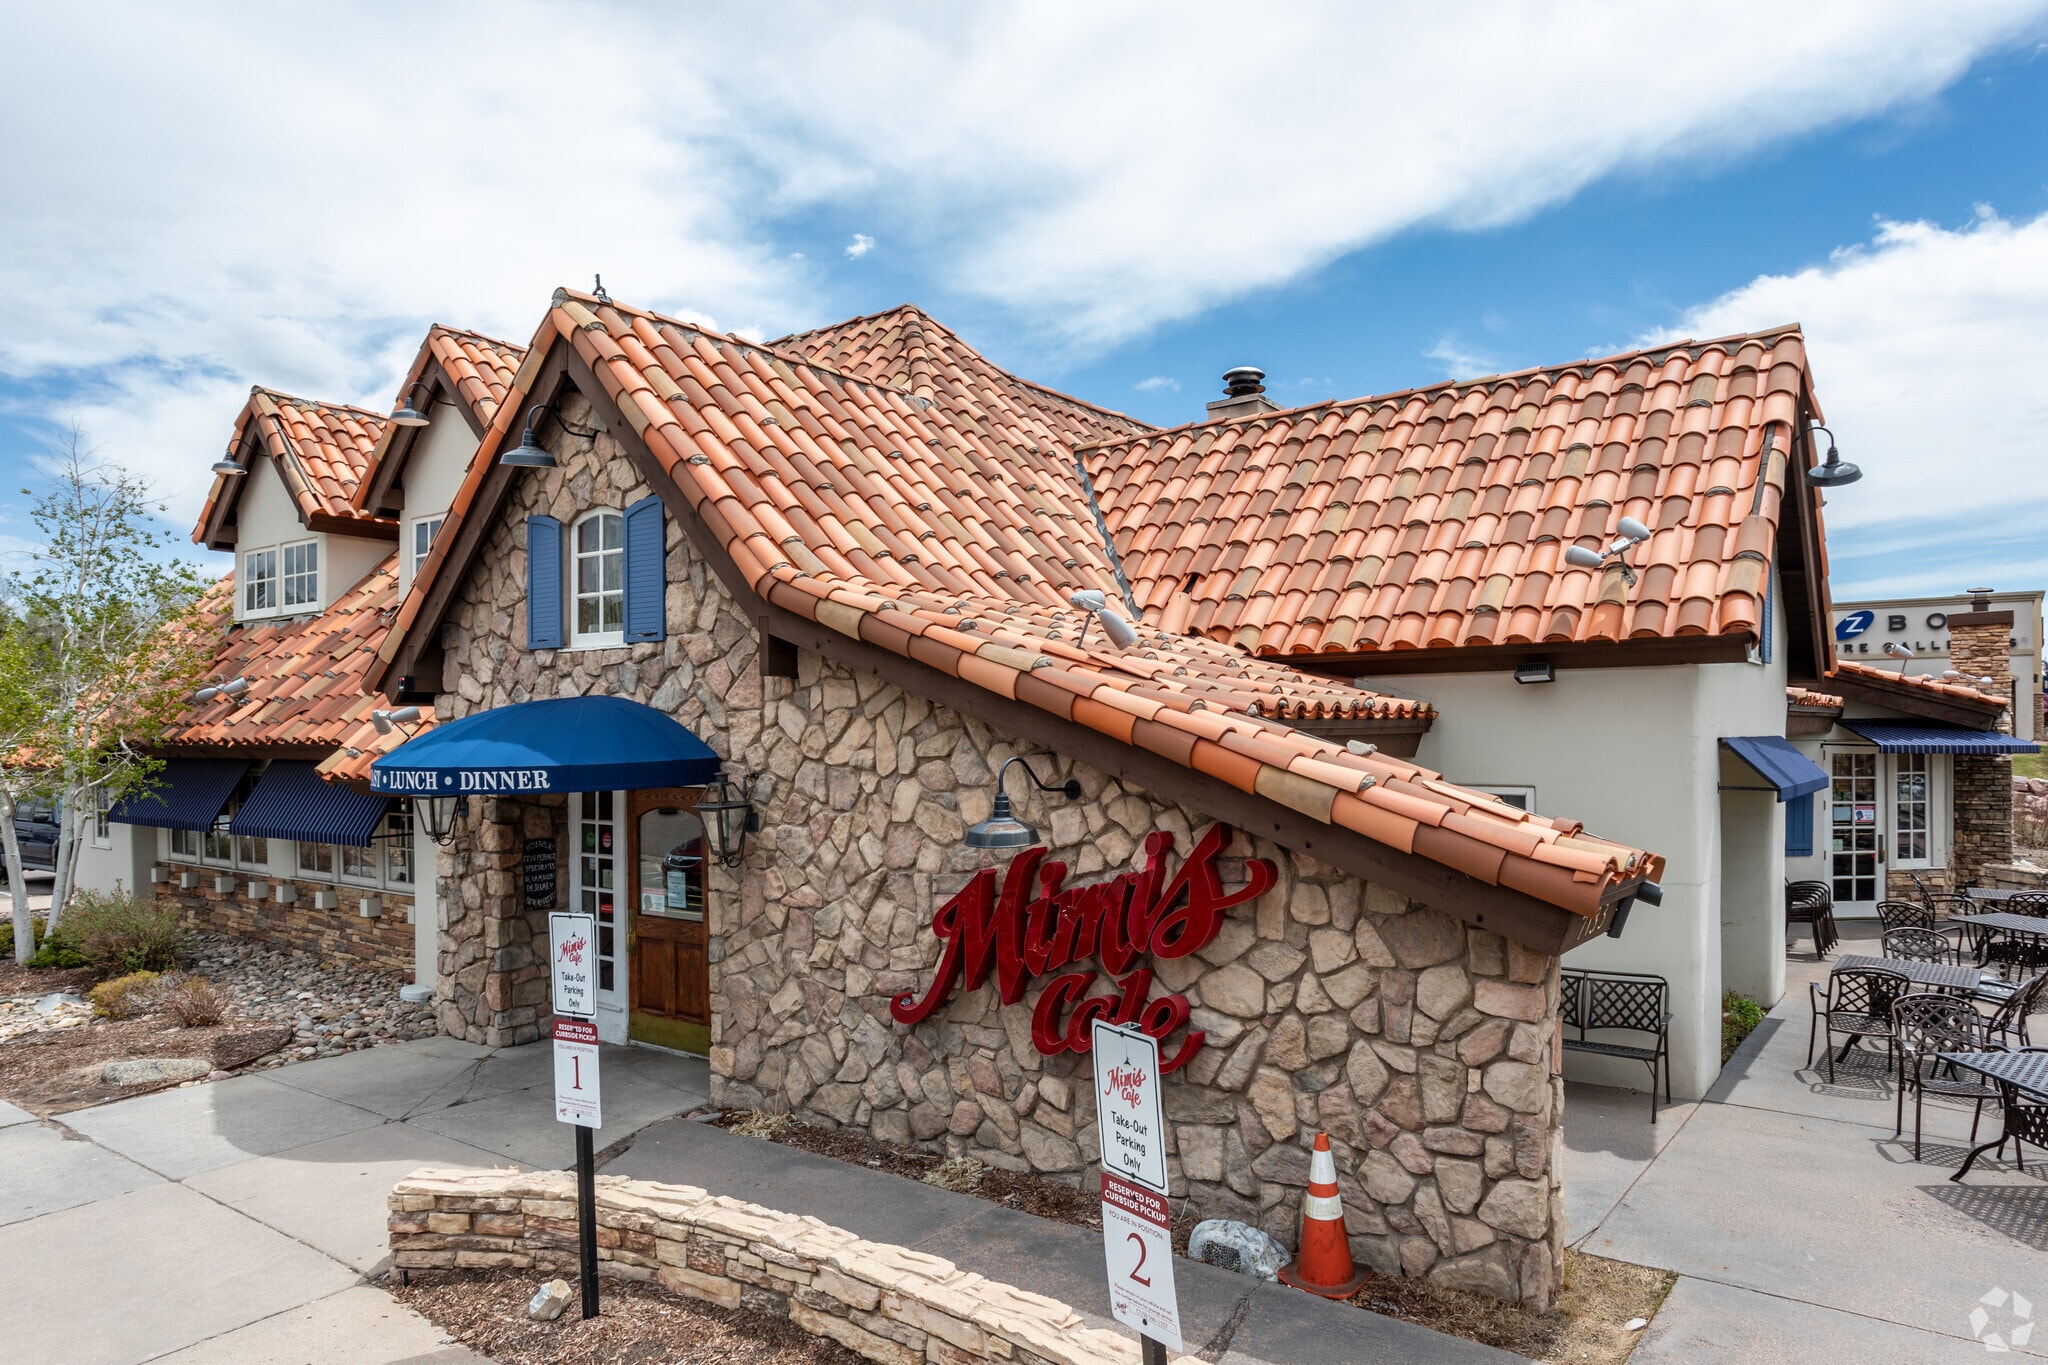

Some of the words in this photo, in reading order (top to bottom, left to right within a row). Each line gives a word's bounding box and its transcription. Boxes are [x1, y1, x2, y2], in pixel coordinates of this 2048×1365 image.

[1888, 613, 1947, 632] BO
[390, 770, 438, 790] LUNCH
[459, 770, 551, 790] DINNER
[561, 971, 586, 982] Take-Out
[564, 984, 584, 997] Parking
[569, 998, 580, 1009] Only
[555, 1030, 578, 1039] CURBSIDE
[578, 1033, 597, 1042] PICKUP
[558, 1023, 582, 1032] RESERVED
[571, 1055, 583, 1090] 1
[1121, 1087, 1141, 1109] Cafe
[1111, 1110, 1147, 1136] Take-Out
[1115, 1131, 1146, 1157] Parking
[1123, 1153, 1141, 1172] Only
[1108, 1180, 1144, 1202] RESERVED
[1145, 1196, 1161, 1210] FOR
[1104, 1189, 1139, 1212] CURBSIDE
[1140, 1204, 1166, 1223] PICKUP
[1108, 1209, 1119, 1220] YOU
[1120, 1215, 1130, 1225] ARE
[1126, 1232, 1152, 1288] 2
